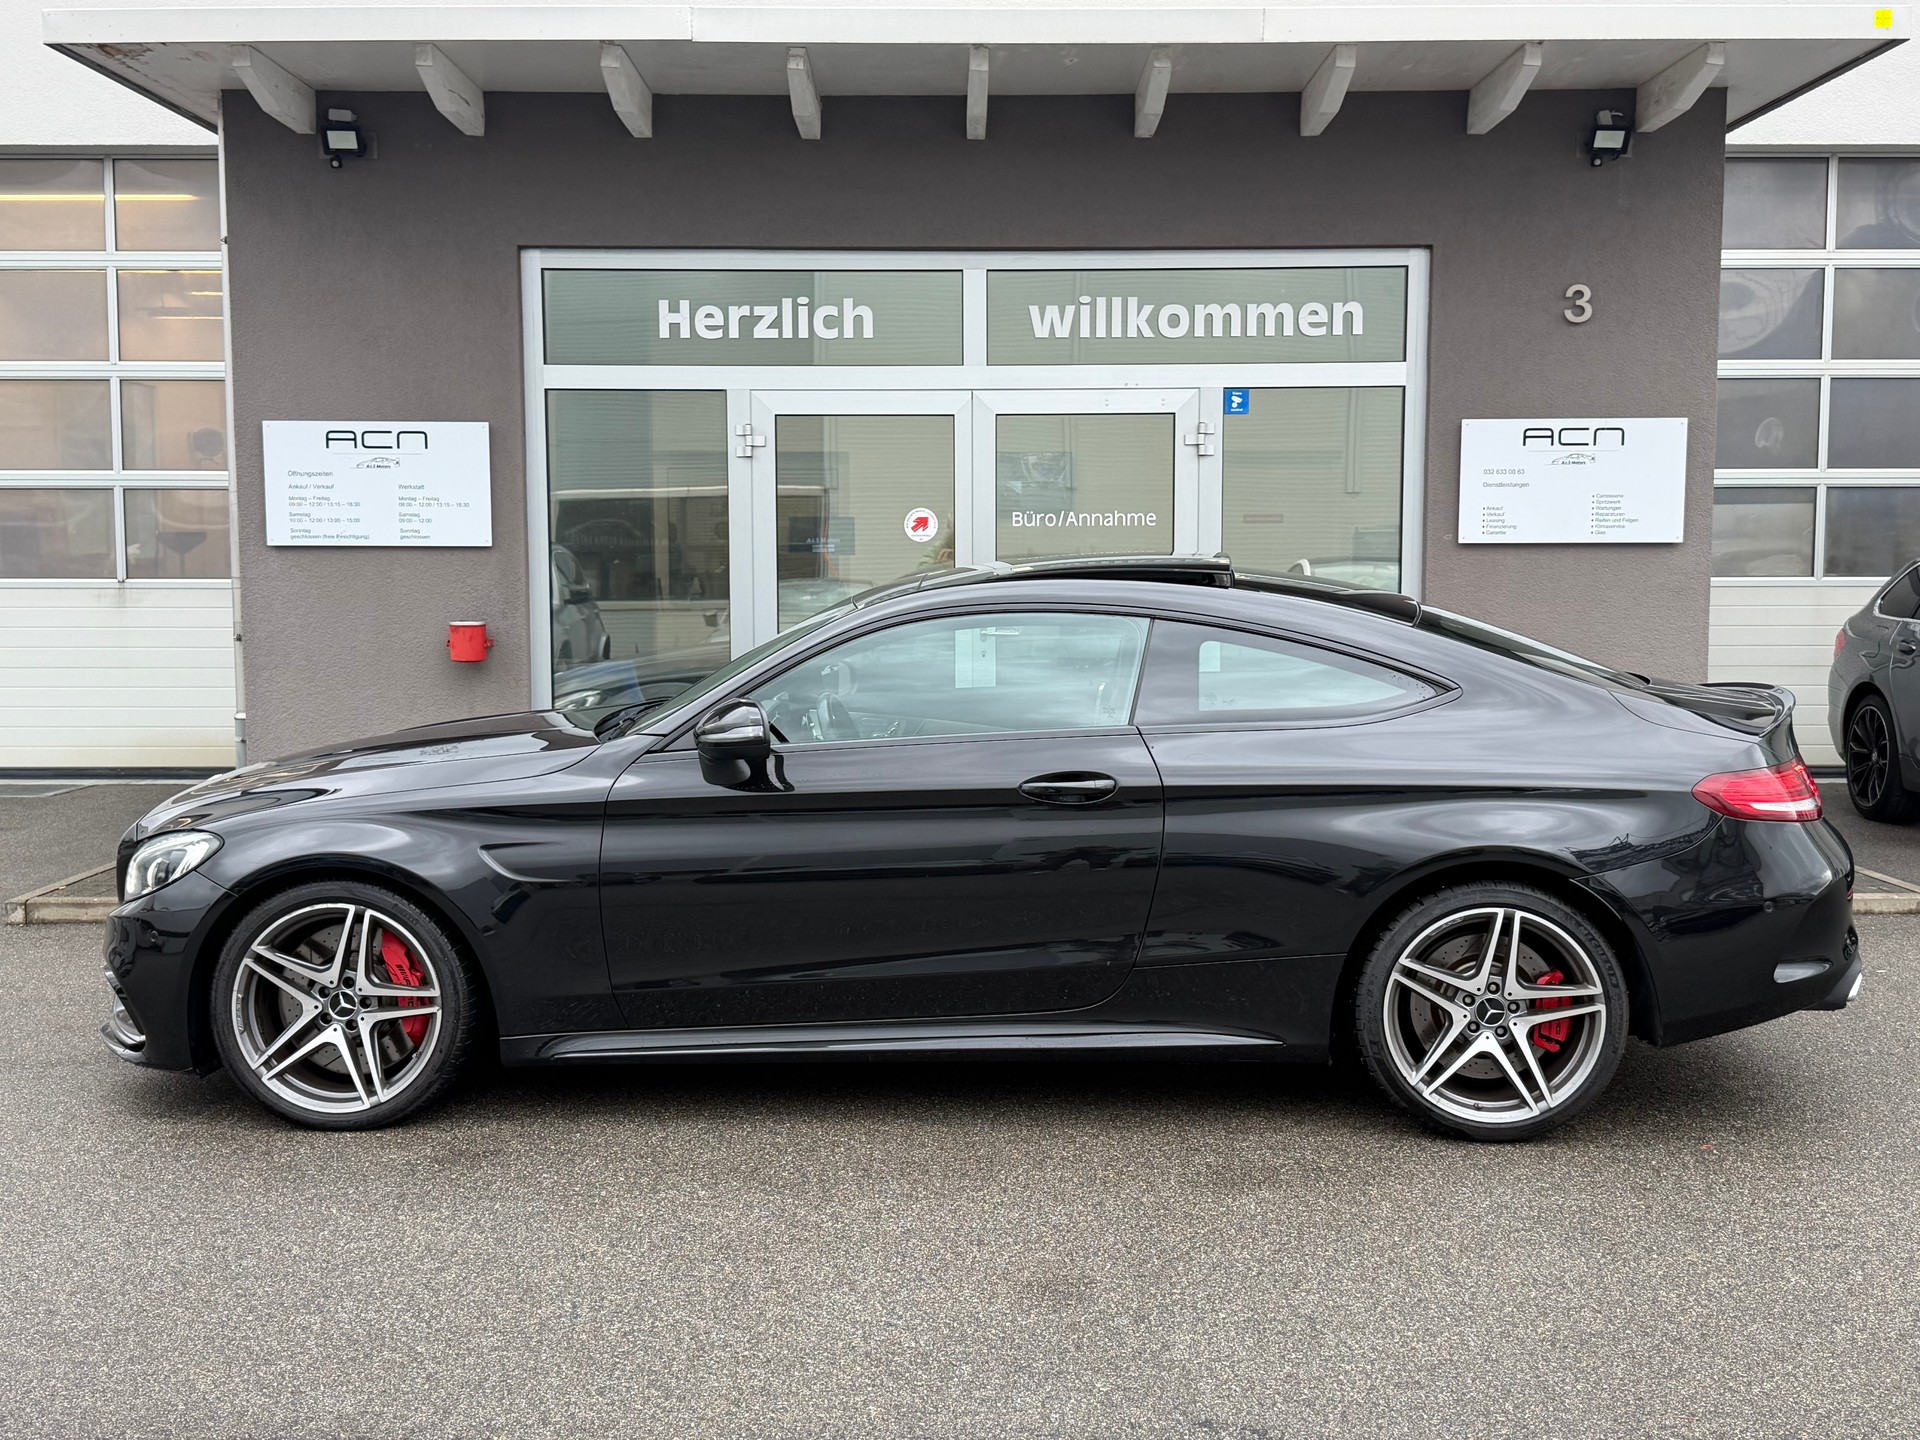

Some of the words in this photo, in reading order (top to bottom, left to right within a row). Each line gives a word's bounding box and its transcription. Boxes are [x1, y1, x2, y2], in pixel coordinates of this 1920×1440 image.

[658, 297, 874, 339] Herzlich
[1028, 295, 1364, 338] willkommen
[1564, 283, 1592, 323] 3
[1012, 510, 1156, 527] Büro/Annahme
